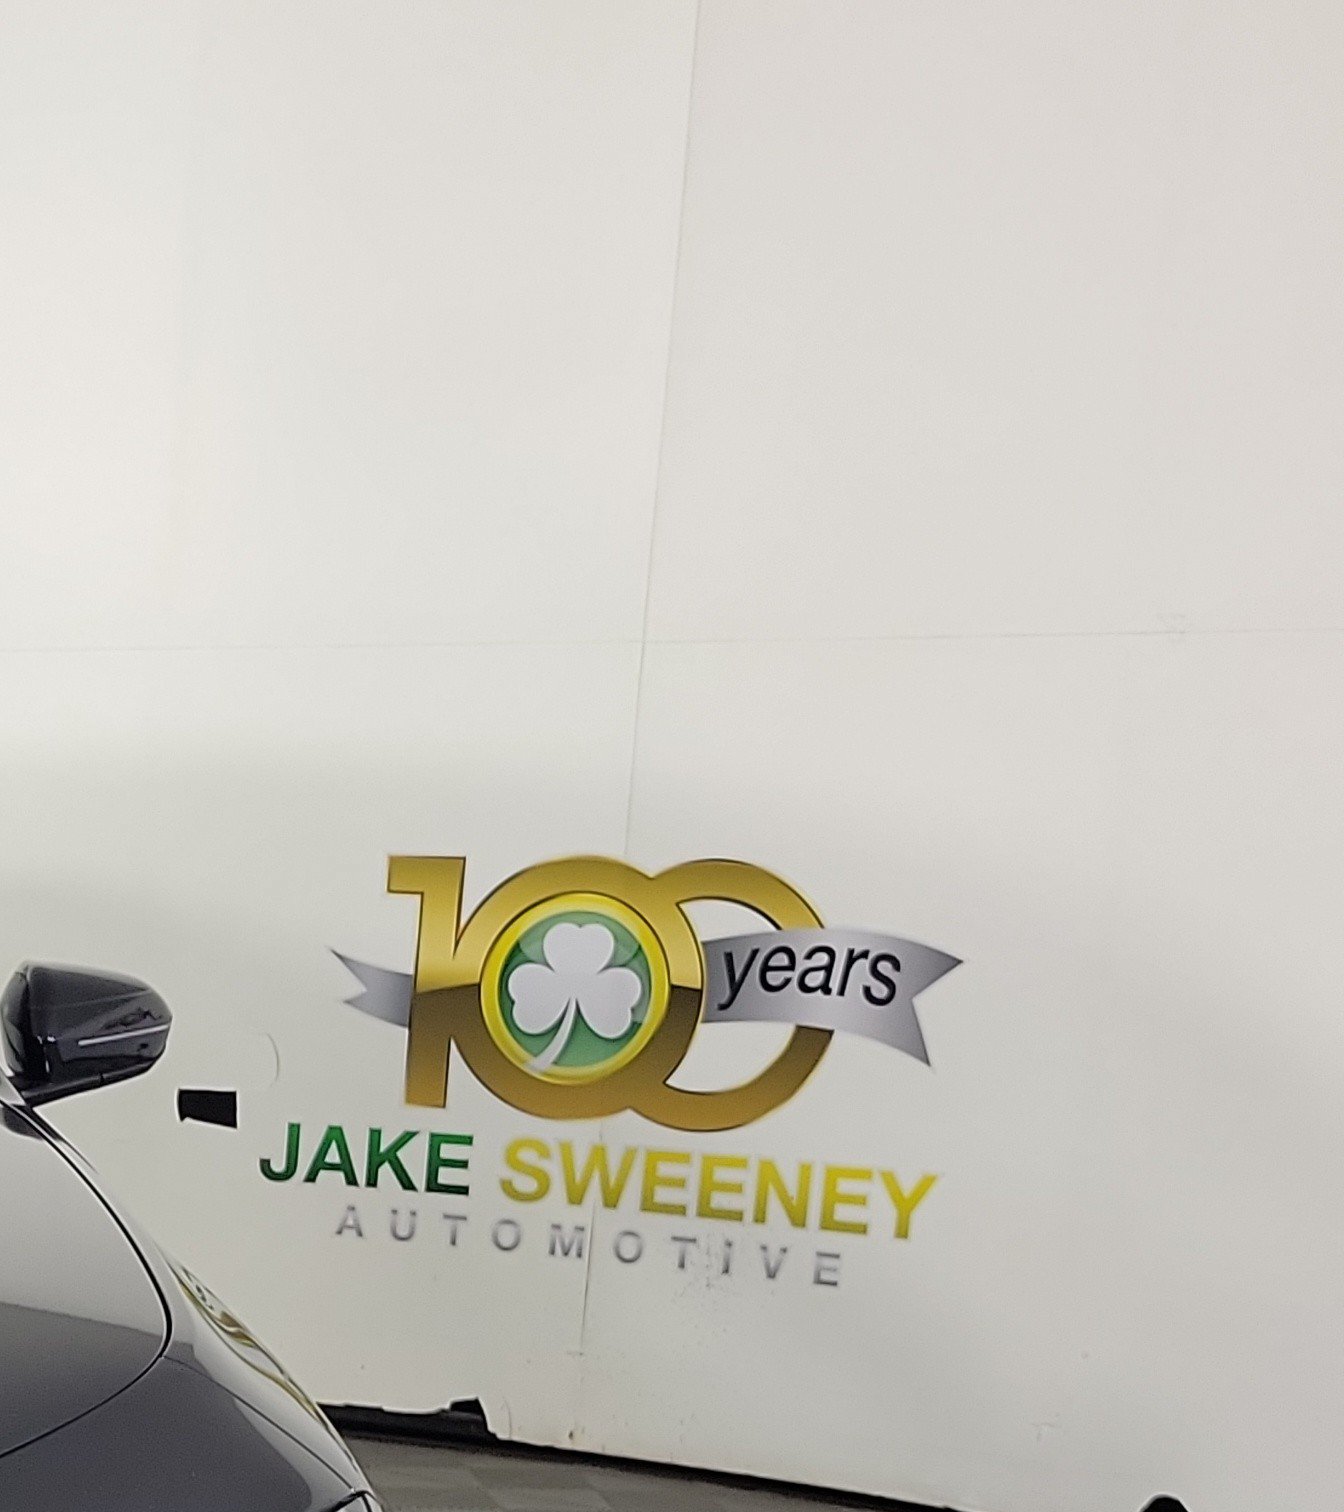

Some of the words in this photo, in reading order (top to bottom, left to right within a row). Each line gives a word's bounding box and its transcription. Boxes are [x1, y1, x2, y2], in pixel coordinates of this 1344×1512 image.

[386, 854, 835, 1133] 100
[716, 943, 903, 1012] years
[258, 1122, 475, 1197] JAKE
[498, 1137, 940, 1241] SWEENEY
[334, 1204, 843, 1289] AUTOMOTIVE
